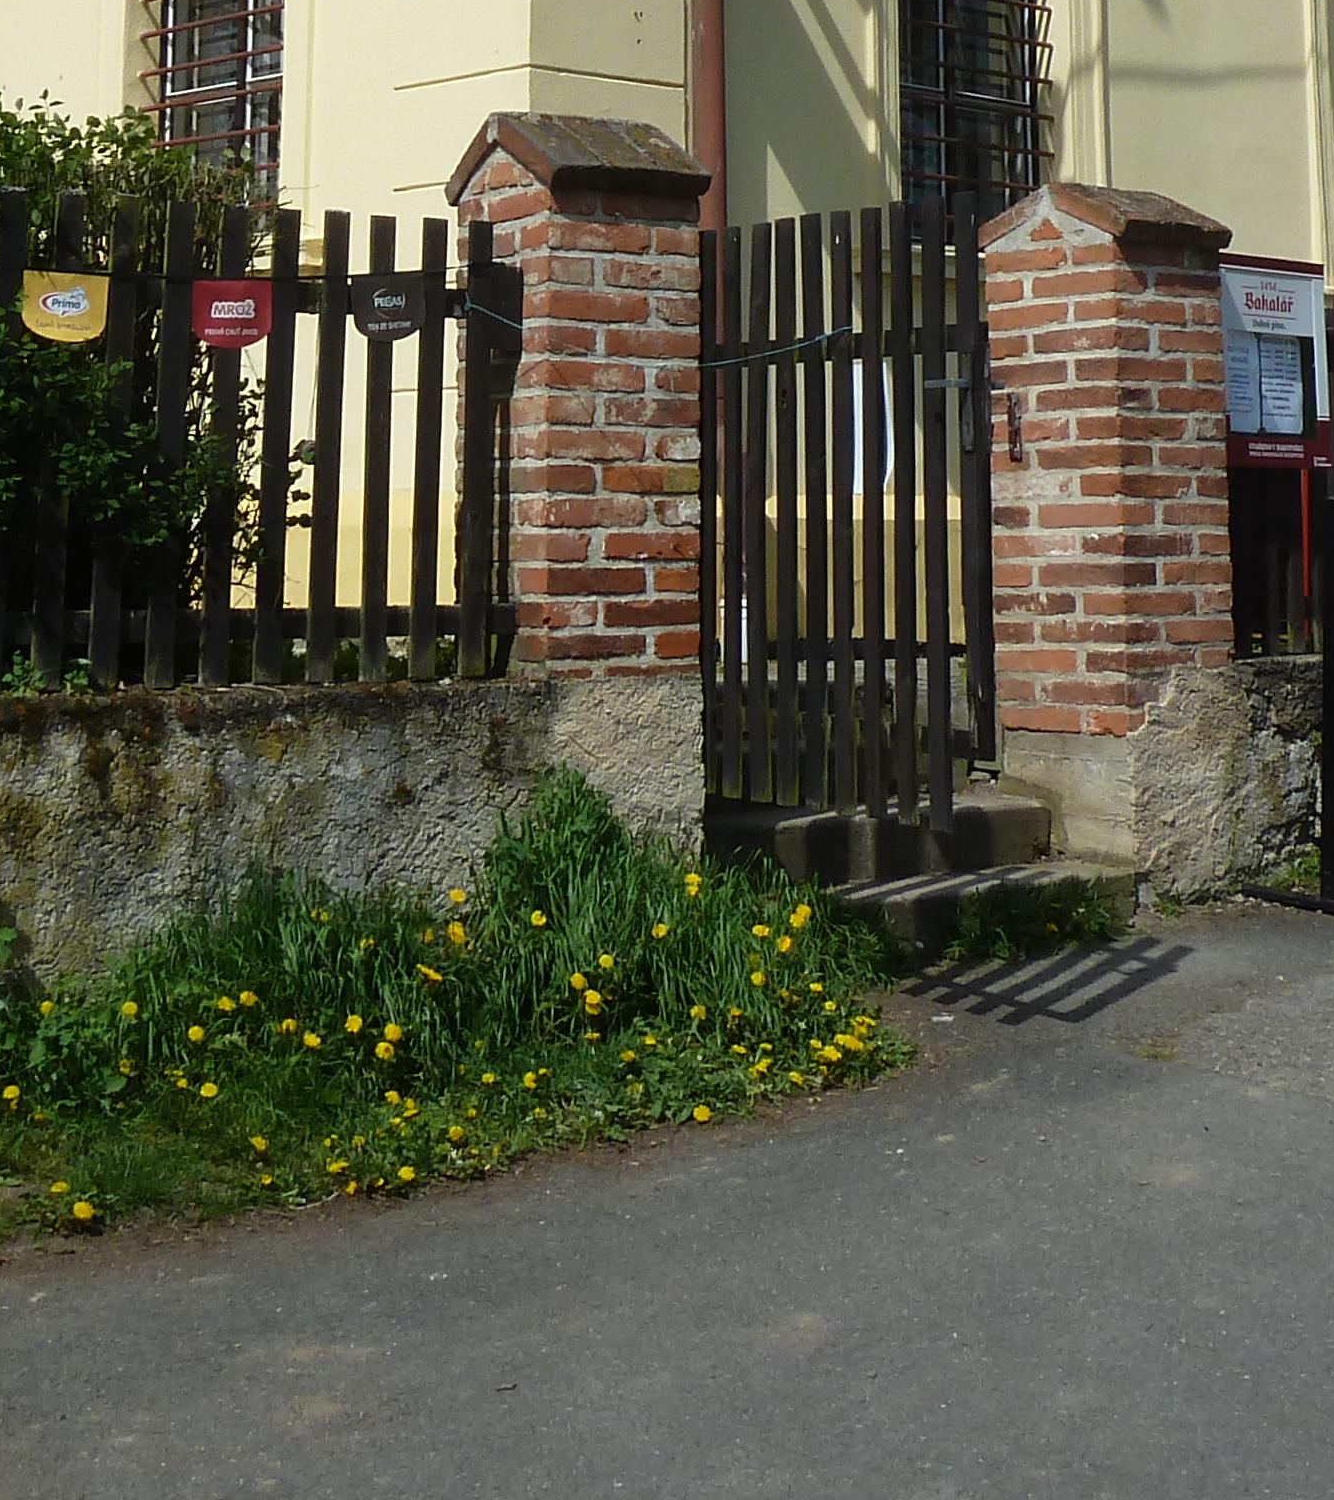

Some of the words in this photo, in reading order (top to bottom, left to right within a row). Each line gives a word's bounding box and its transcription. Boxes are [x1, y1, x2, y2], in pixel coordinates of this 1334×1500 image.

[51, 298, 81, 309] Prima
[213, 301, 253, 316] MROŽ
[374, 296, 402, 308] PEGAS
[1244, 291, 1294, 314] Bakalář
